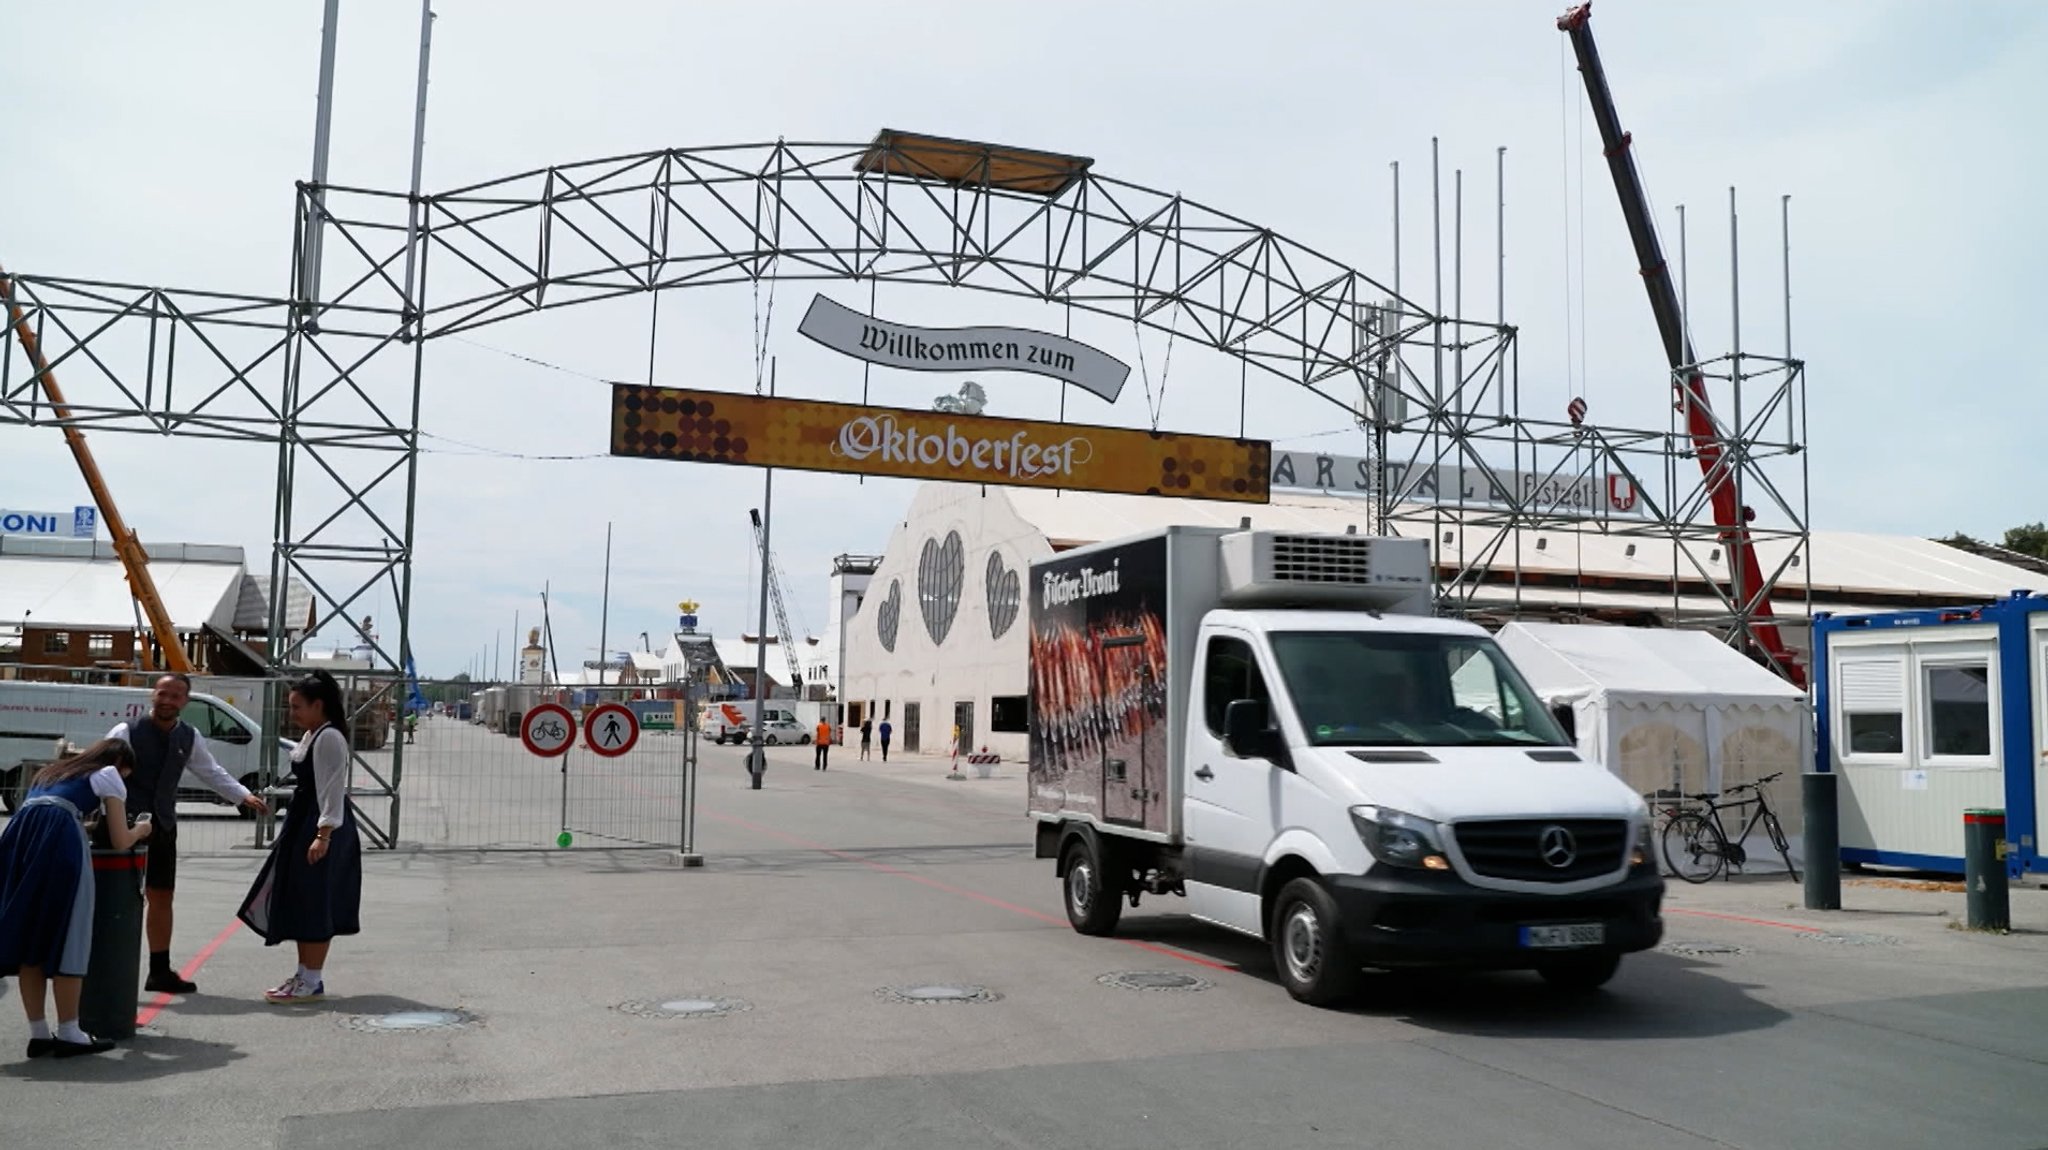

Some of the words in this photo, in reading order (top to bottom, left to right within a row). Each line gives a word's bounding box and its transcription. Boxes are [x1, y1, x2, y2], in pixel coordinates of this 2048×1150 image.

[859, 324, 1019, 361] Willkommen
[1026, 344, 1075, 372] zum
[830, 413, 1093, 480] Oktoberfest
[0, 513, 56, 533] ONI
